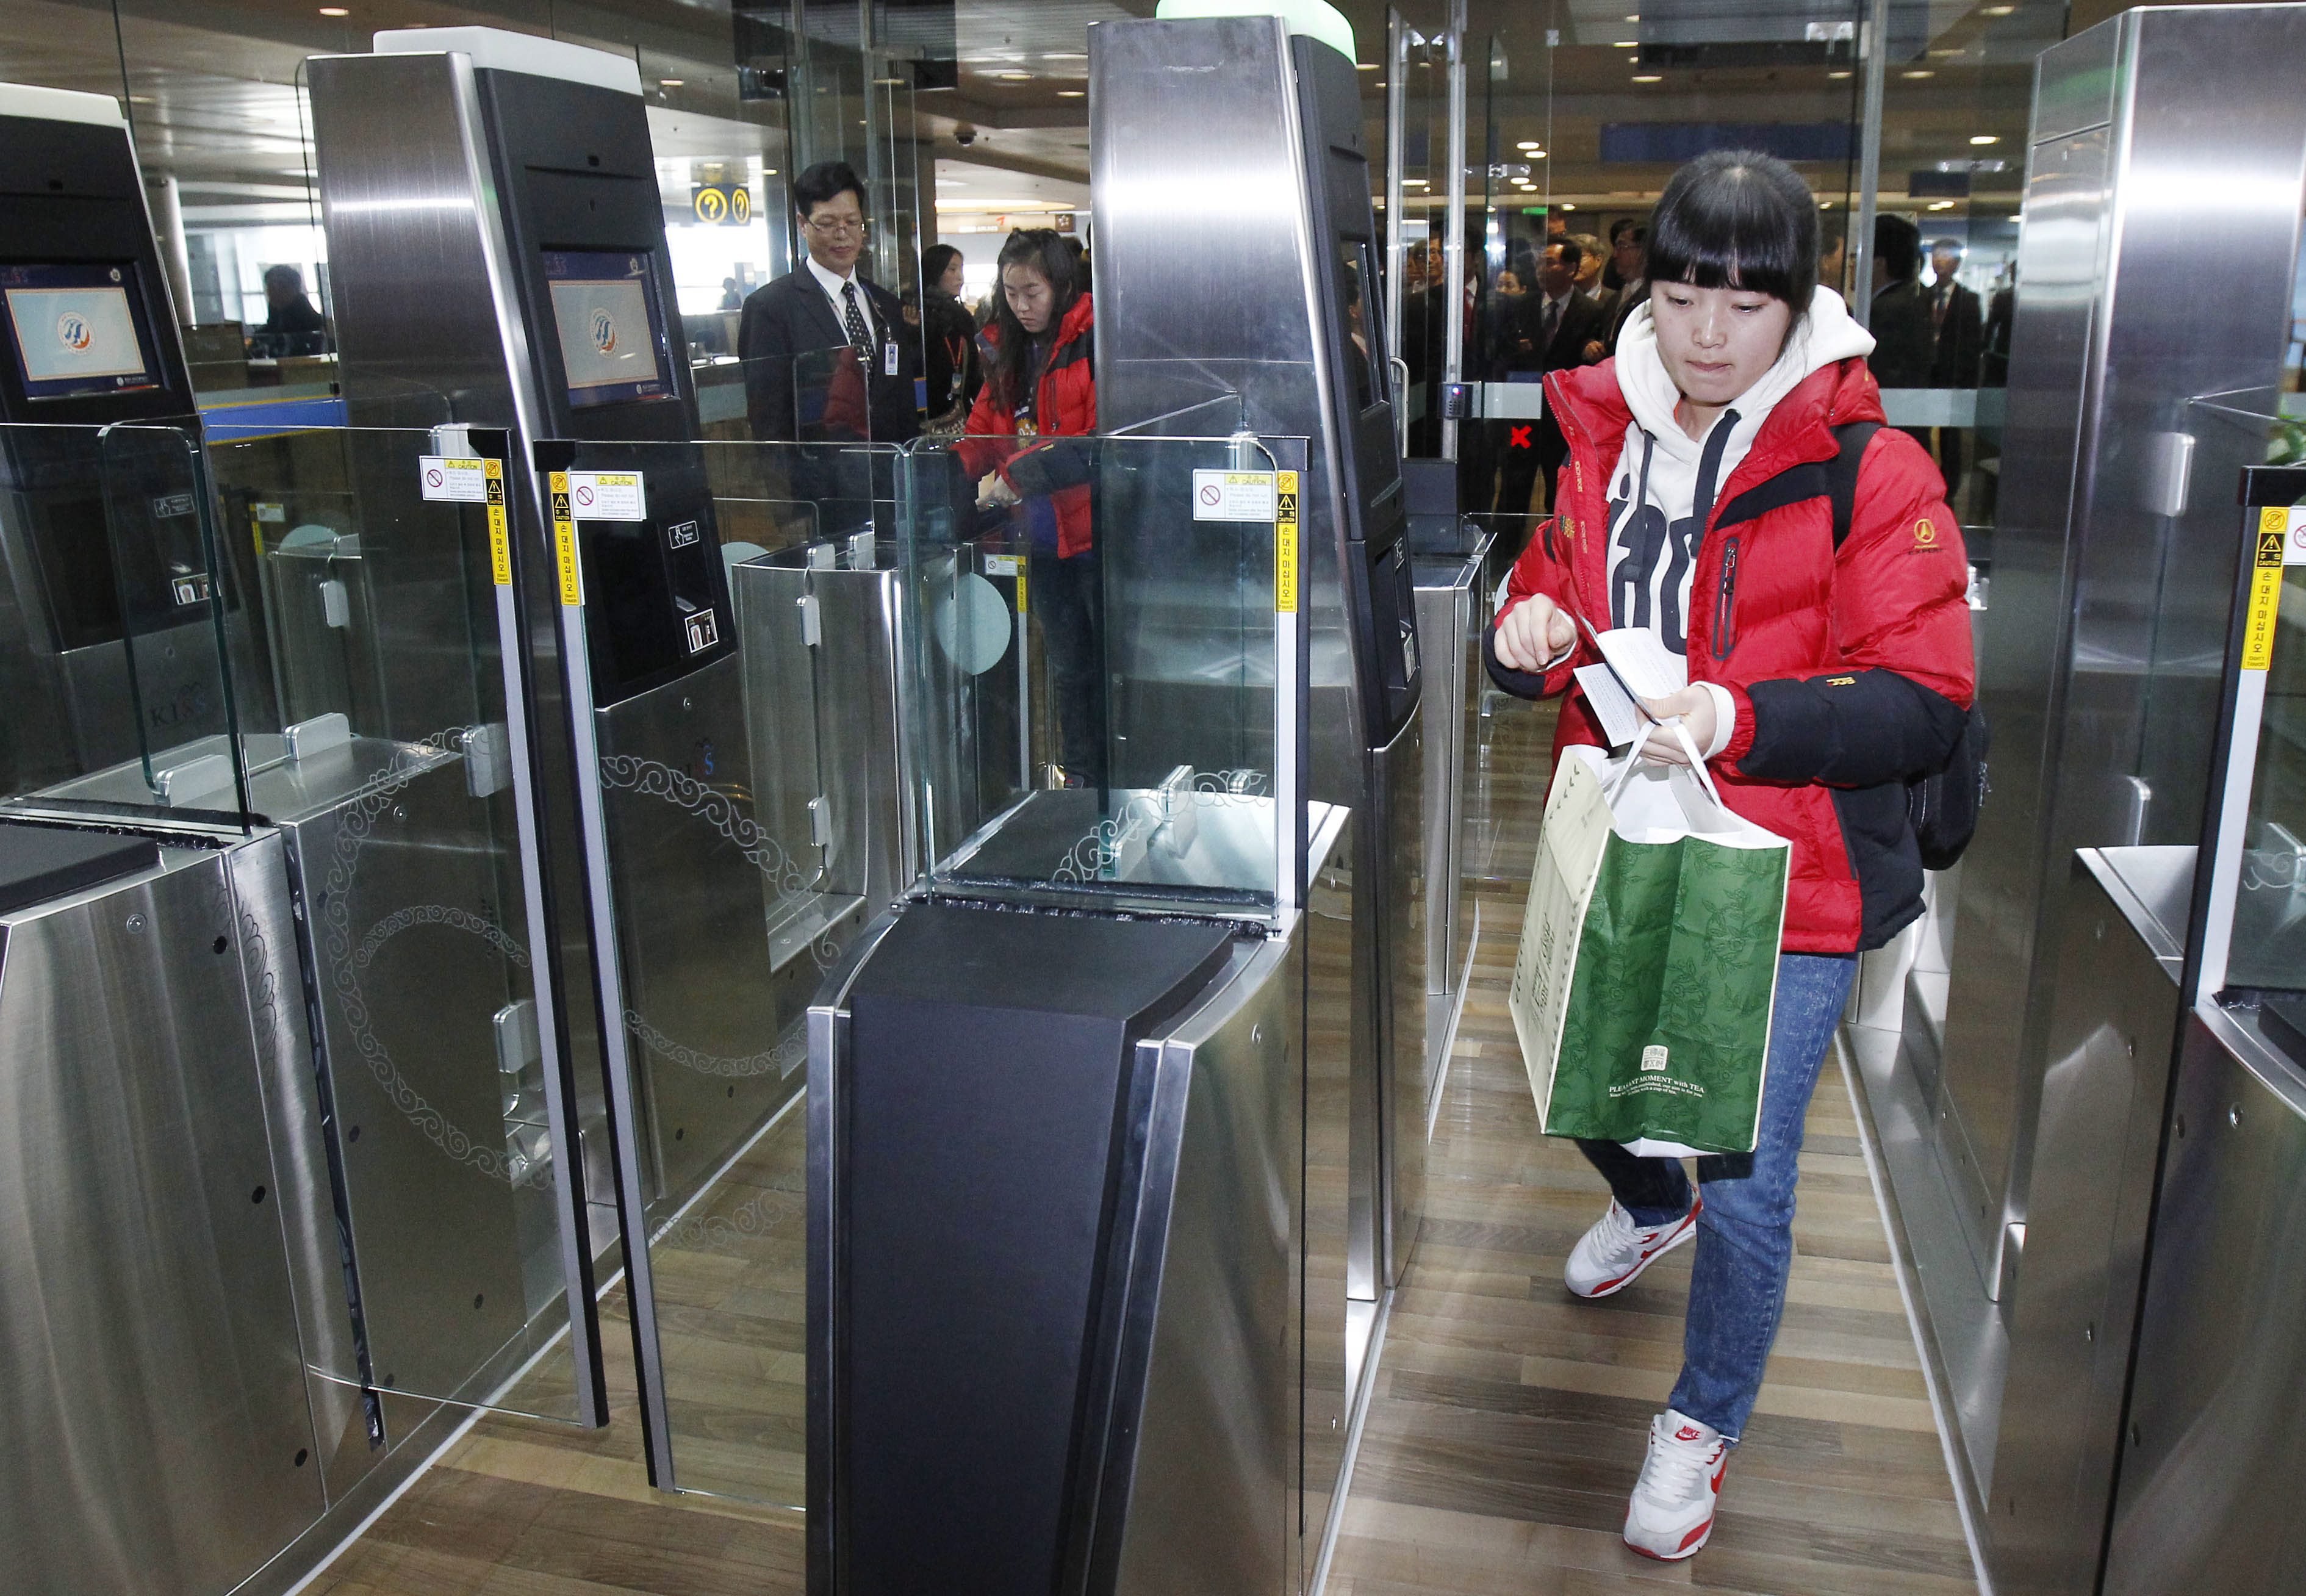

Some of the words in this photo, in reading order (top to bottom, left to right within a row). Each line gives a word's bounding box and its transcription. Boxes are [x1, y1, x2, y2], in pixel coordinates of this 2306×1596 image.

[494, 519, 501, 534] 대지
[561, 536, 569, 552] 대지
[1283, 539, 1290, 556] 대지
[496, 538, 505, 571] 마십시오
[564, 556, 572, 591] 마십시오
[2263, 572, 2272, 581] 손
[2259, 585, 2270, 605] 대지
[2253, 610, 2268, 653] 마십시오
[1639, 1074, 1673, 1084] MOMENT
[1689, 1083, 1705, 1093] TEA
[1682, 1425, 1701, 1438] NIKE
